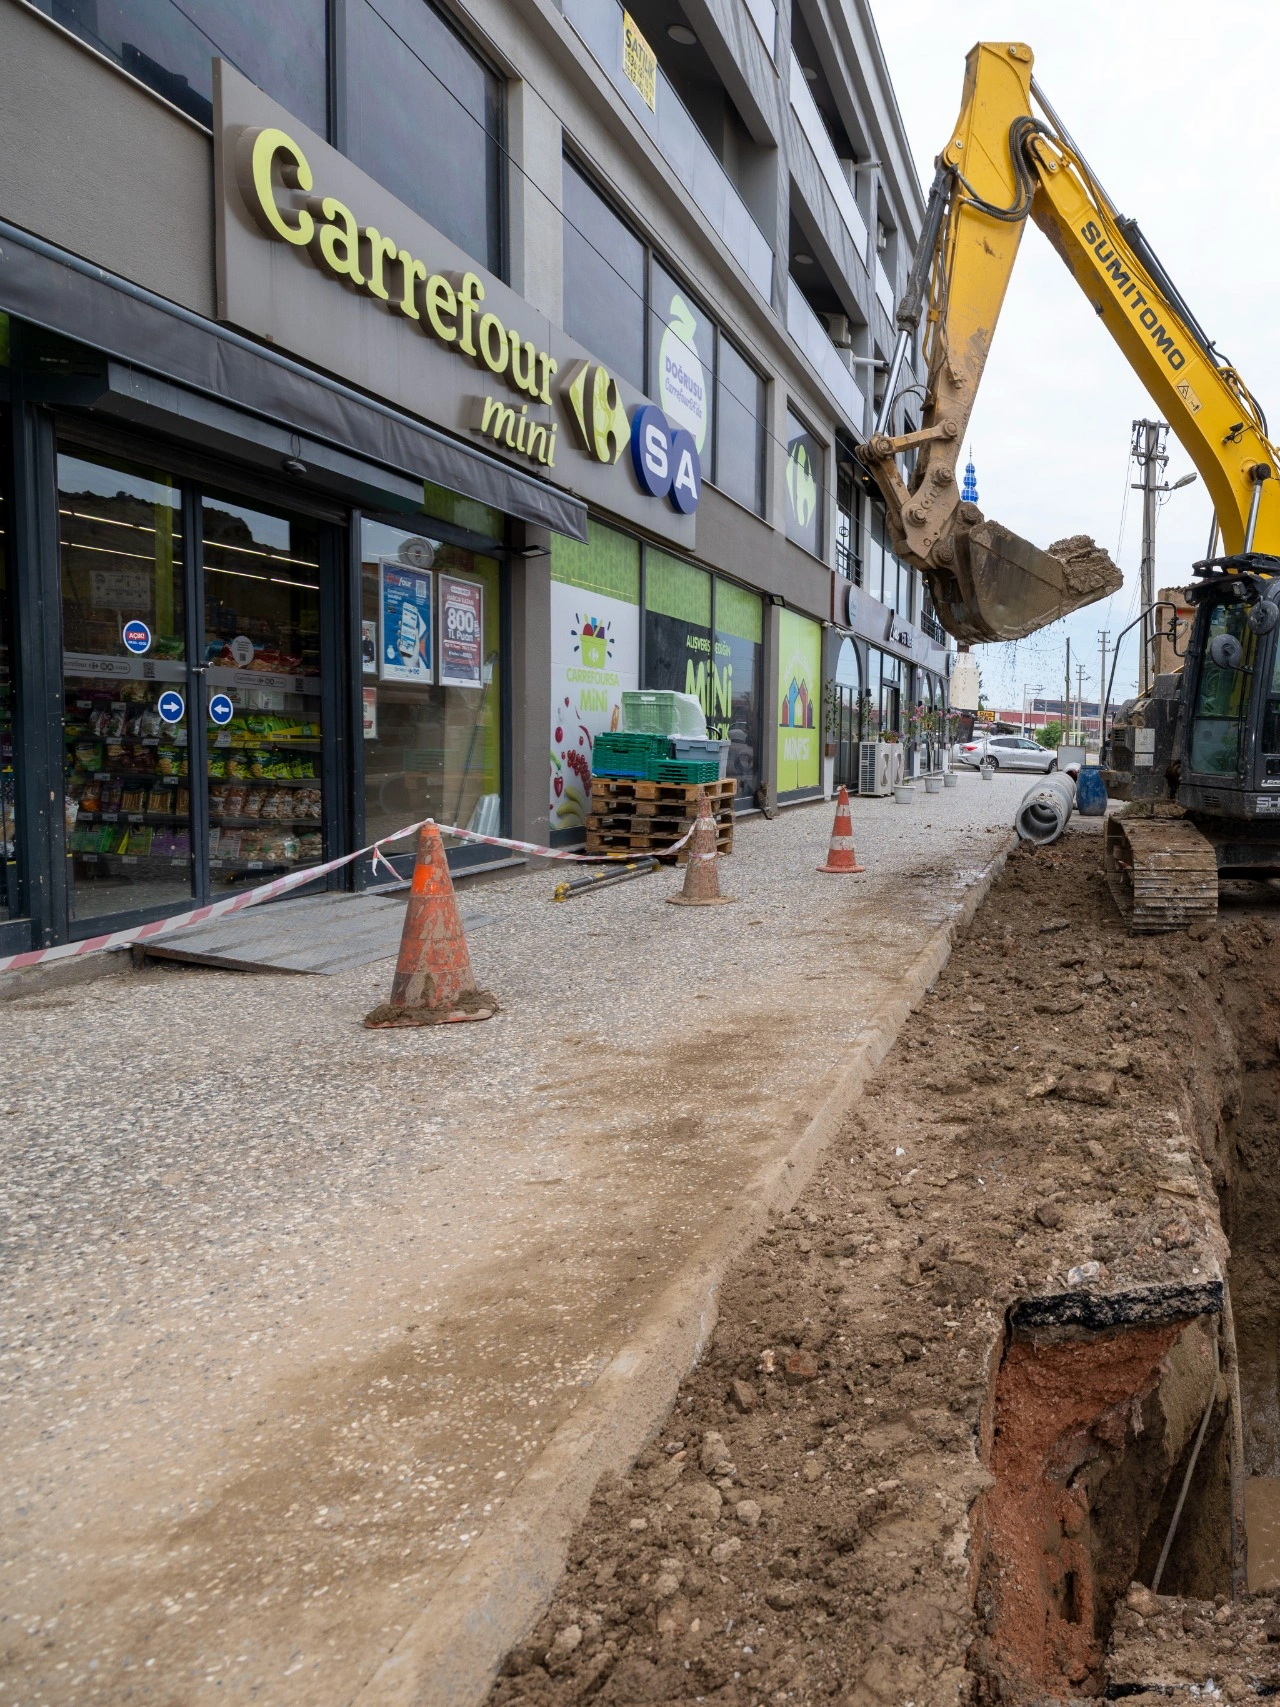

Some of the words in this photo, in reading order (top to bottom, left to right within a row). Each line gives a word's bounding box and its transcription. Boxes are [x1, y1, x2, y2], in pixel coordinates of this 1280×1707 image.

[625, 29, 655, 79] SATILIK
[252, 128, 557, 406] Carrefour
[1080, 220, 1186, 371] SUMITOMO
[665, 354, 703, 402] DOĞRUSU
[480, 395, 556, 468] mini
[645, 423, 699, 500] SA
[447, 608, 474, 633] 800
[447, 628, 455, 639] TL
[566, 667, 620, 687] CARREFOURSA
